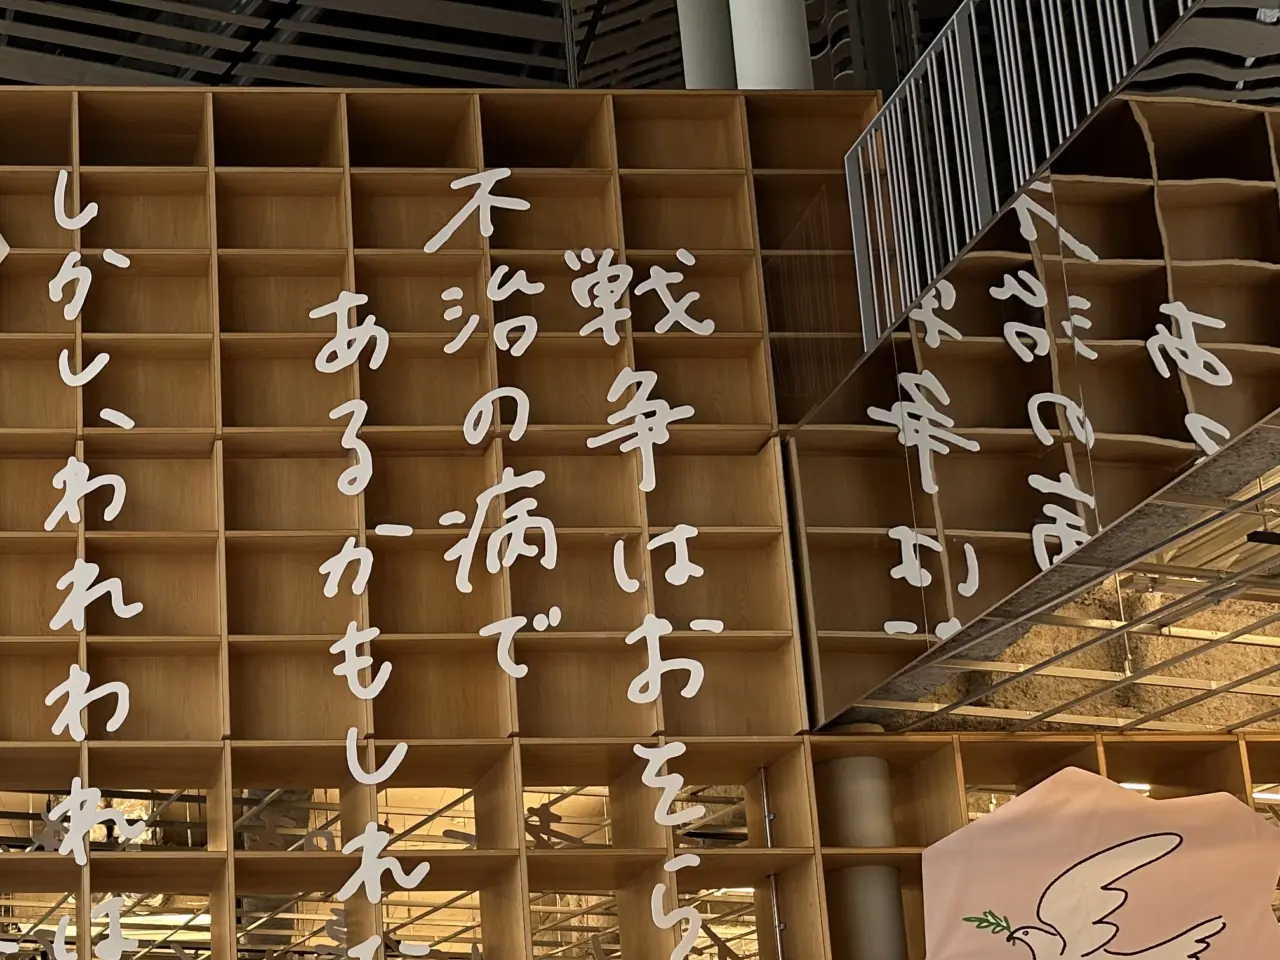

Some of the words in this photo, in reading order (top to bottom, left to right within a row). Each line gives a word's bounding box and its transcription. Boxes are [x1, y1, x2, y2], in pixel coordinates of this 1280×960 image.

[423, 167, 561, 680] 不治の病で
